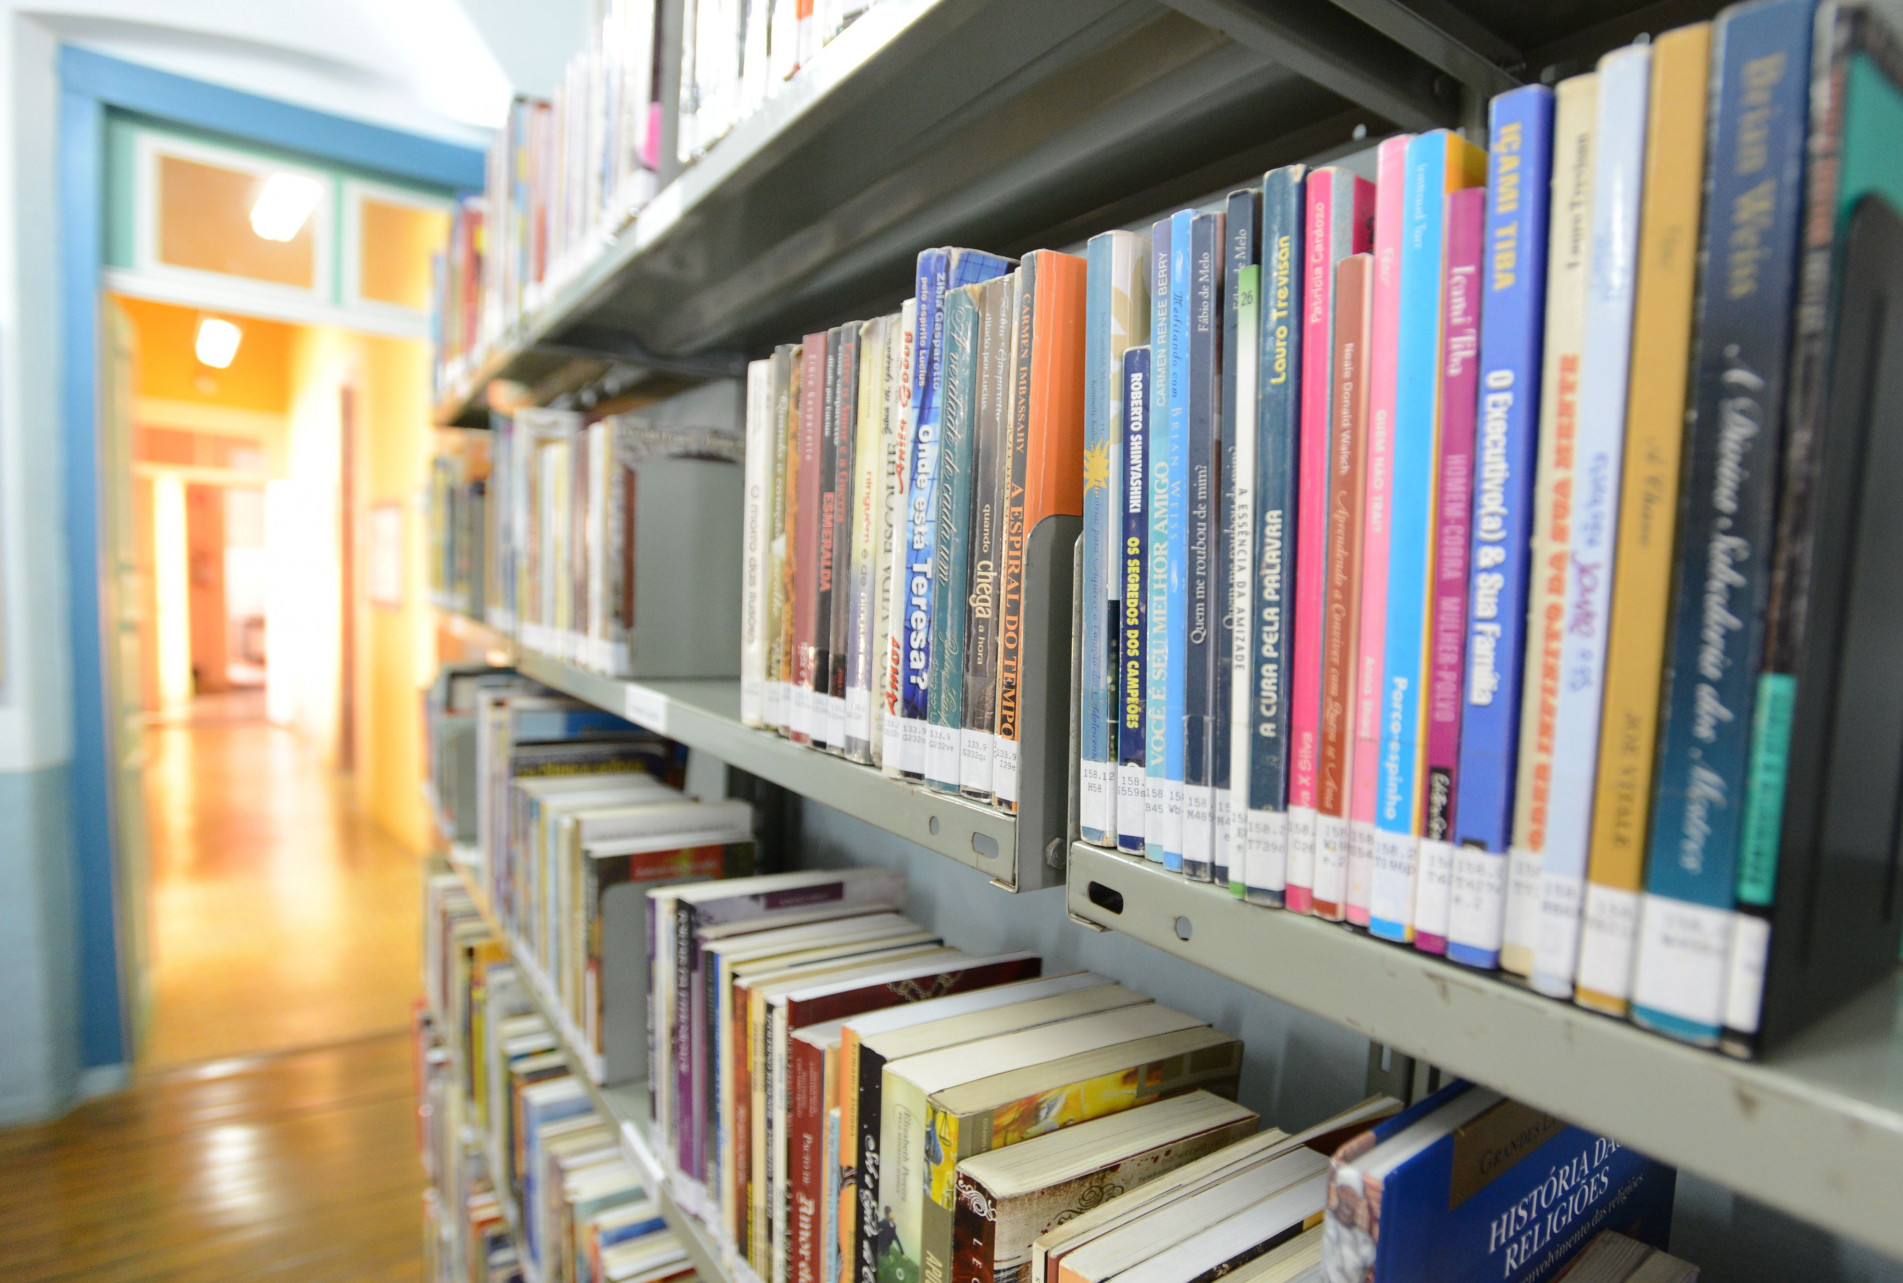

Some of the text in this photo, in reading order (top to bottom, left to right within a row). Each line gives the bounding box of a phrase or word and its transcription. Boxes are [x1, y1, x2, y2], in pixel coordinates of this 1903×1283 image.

[1492, 121, 1522, 292] IÇAMI TIBA
[1727, 50, 1787, 302] Brian Weiss
[1234, 228, 1248, 260] Melo
[1310, 202, 1326, 324] Patricia Cardozo
[1156, 252, 1169, 407] CARMEN RENEE BERRY
[1196, 252, 1210, 333] Fábio de Melo
[1270, 235, 1291, 386] Lauro Trevisan
[918, 350, 927, 388] Lucius
[932, 311, 945, 391] Gasparetto
[1015, 293, 1032, 454] CARMEN IMBASSAHY
[1170, 290, 1185, 399] Meditando com
[1446, 328, 1478, 378] Tiba
[946, 352, 965, 445] verdade
[1128, 372, 1143, 514] ROBERTO SHINYASHIKI
[1339, 342, 1354, 475] Neale Donald Walsch
[1374, 409, 1388, 453] QUEM
[1554, 352, 1580, 471] MENTE
[942, 449, 961, 480] de
[1011, 482, 1024, 499] A
[1169, 407, 1183, 541] BRIAN WEISS
[1372, 456, 1386, 490] NÃO
[1712, 395, 1766, 517] Divina
[819, 492, 834, 592] ESMERALDA
[909, 424, 933, 690] Onde está Teresa?
[937, 484, 958, 544] cada
[1005, 506, 1024, 608] ESPIRAL
[1190, 464, 1208, 645] Quem me roubou de mim?
[1334, 490, 1349, 587] Aprendendo
[1469, 368, 1516, 706] O Executivo(a) & Sua Família
[1551, 475, 1573, 545] SUA
[937, 545, 950, 587] um
[969, 503, 998, 665] quando chega hora
[1235, 487, 1251, 671] A ESSÊNCIA DA AMIZADE
[1432, 453, 1468, 723] HOMEM-COBRA MULHER-POLVO
[1546, 550, 1569, 598] DA
[1696, 514, 1750, 682] Sabedoria
[1004, 615, 1018, 649] DO
[1125, 536, 1140, 729] OS SEGREDOS DOS CAMPEÕES
[1148, 461, 1170, 767] VOCÊ É SEU MELHOR AMIGO
[1260, 509, 1282, 738] A CURA PELA PALAVRA
[1329, 603, 1346, 665] Conviver
[885, 636, 900, 716] Amor
[1001, 655, 1017, 740] TEMPO
[1324, 697, 1343, 742] Quem
[1328, 667, 1340, 698] com
[1363, 656, 1376, 695] Anna
[1537, 601, 1564, 756] INFINITO
[1692, 681, 1735, 745] dos
[967, 740, 987, 751] 133.9
[1083, 767, 1116, 782] 158.12
[1087, 782, 1102, 793] H58
[1121, 775, 1145, 787] 158.
[1146, 787, 1164, 799] 158
[1297, 732, 1313, 786] X Silva
[1383, 676, 1409, 820] Porco-espinho
[1145, 802, 1164, 814] B45
[1678, 744, 1729, 876] Mestres
[1487, 1149, 1590, 1257] HISTÓRIA
[1503, 1165, 1610, 1280] RELIGIÕES
[1590, 1172, 1645, 1228] das religiões
